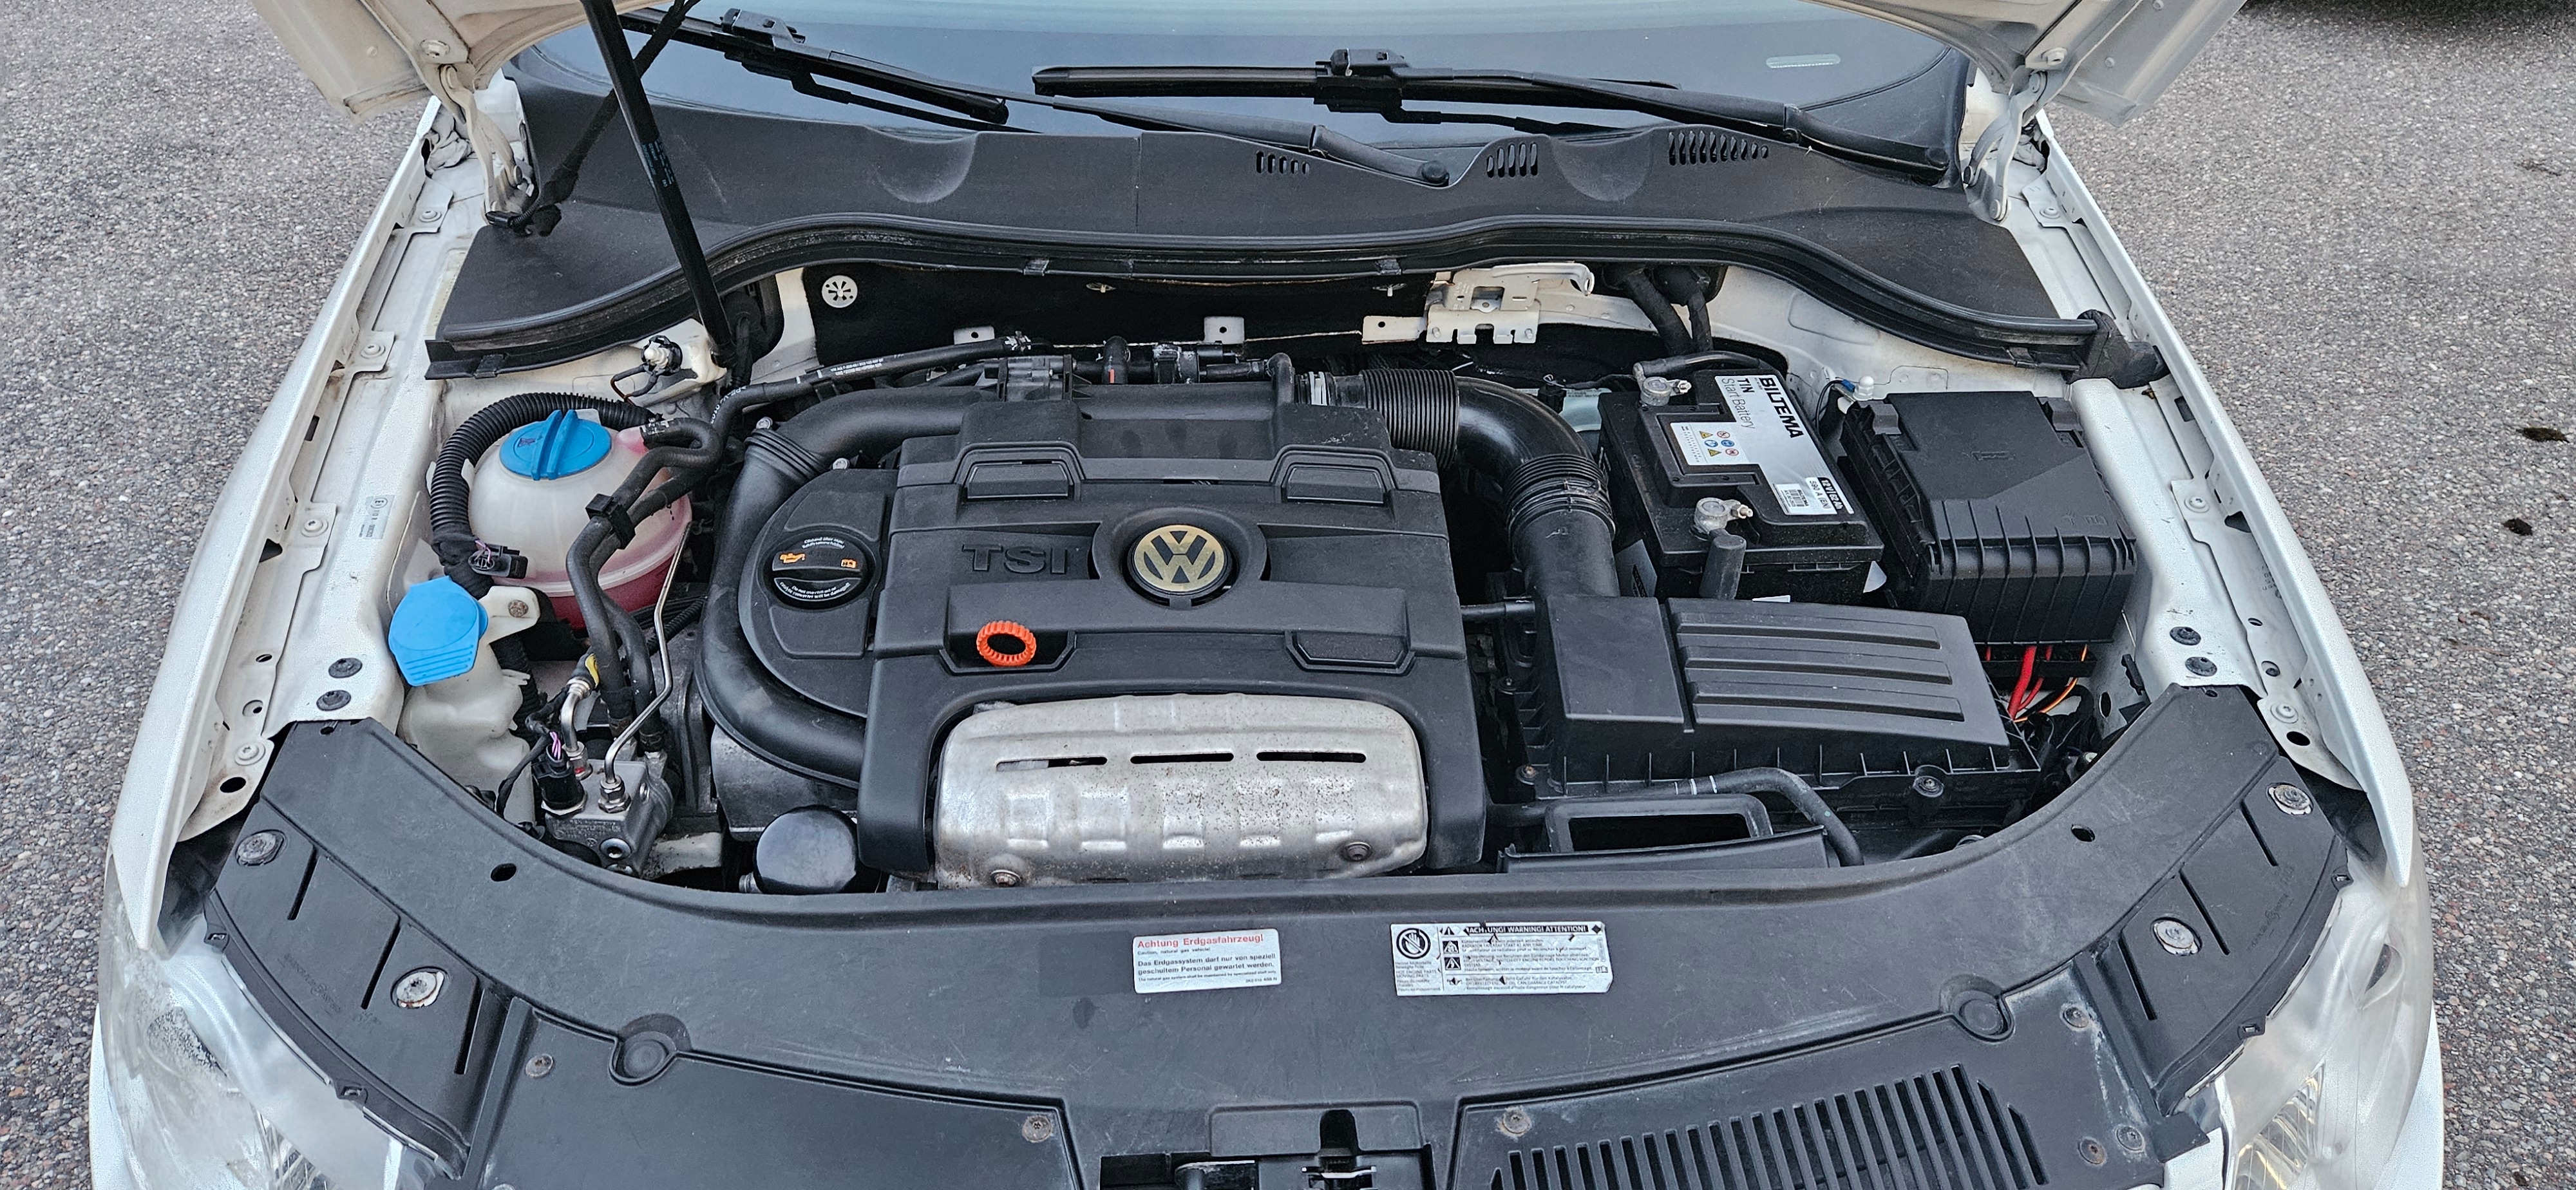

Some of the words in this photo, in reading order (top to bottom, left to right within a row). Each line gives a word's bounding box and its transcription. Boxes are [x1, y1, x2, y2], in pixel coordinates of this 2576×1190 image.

[1738, 378, 1755, 393] TIN
[1721, 378, 1741, 397] Start
[1732, 399, 1755, 429] Battery
[1759, 378, 1804, 438] BILTEMA
[962, 544, 1068, 574] TSI
[1134, 525, 1225, 592] VW
[1183, 934, 1263, 945] Erdgasfahrzeug!
[1138, 967, 1179, 976] geschultem
